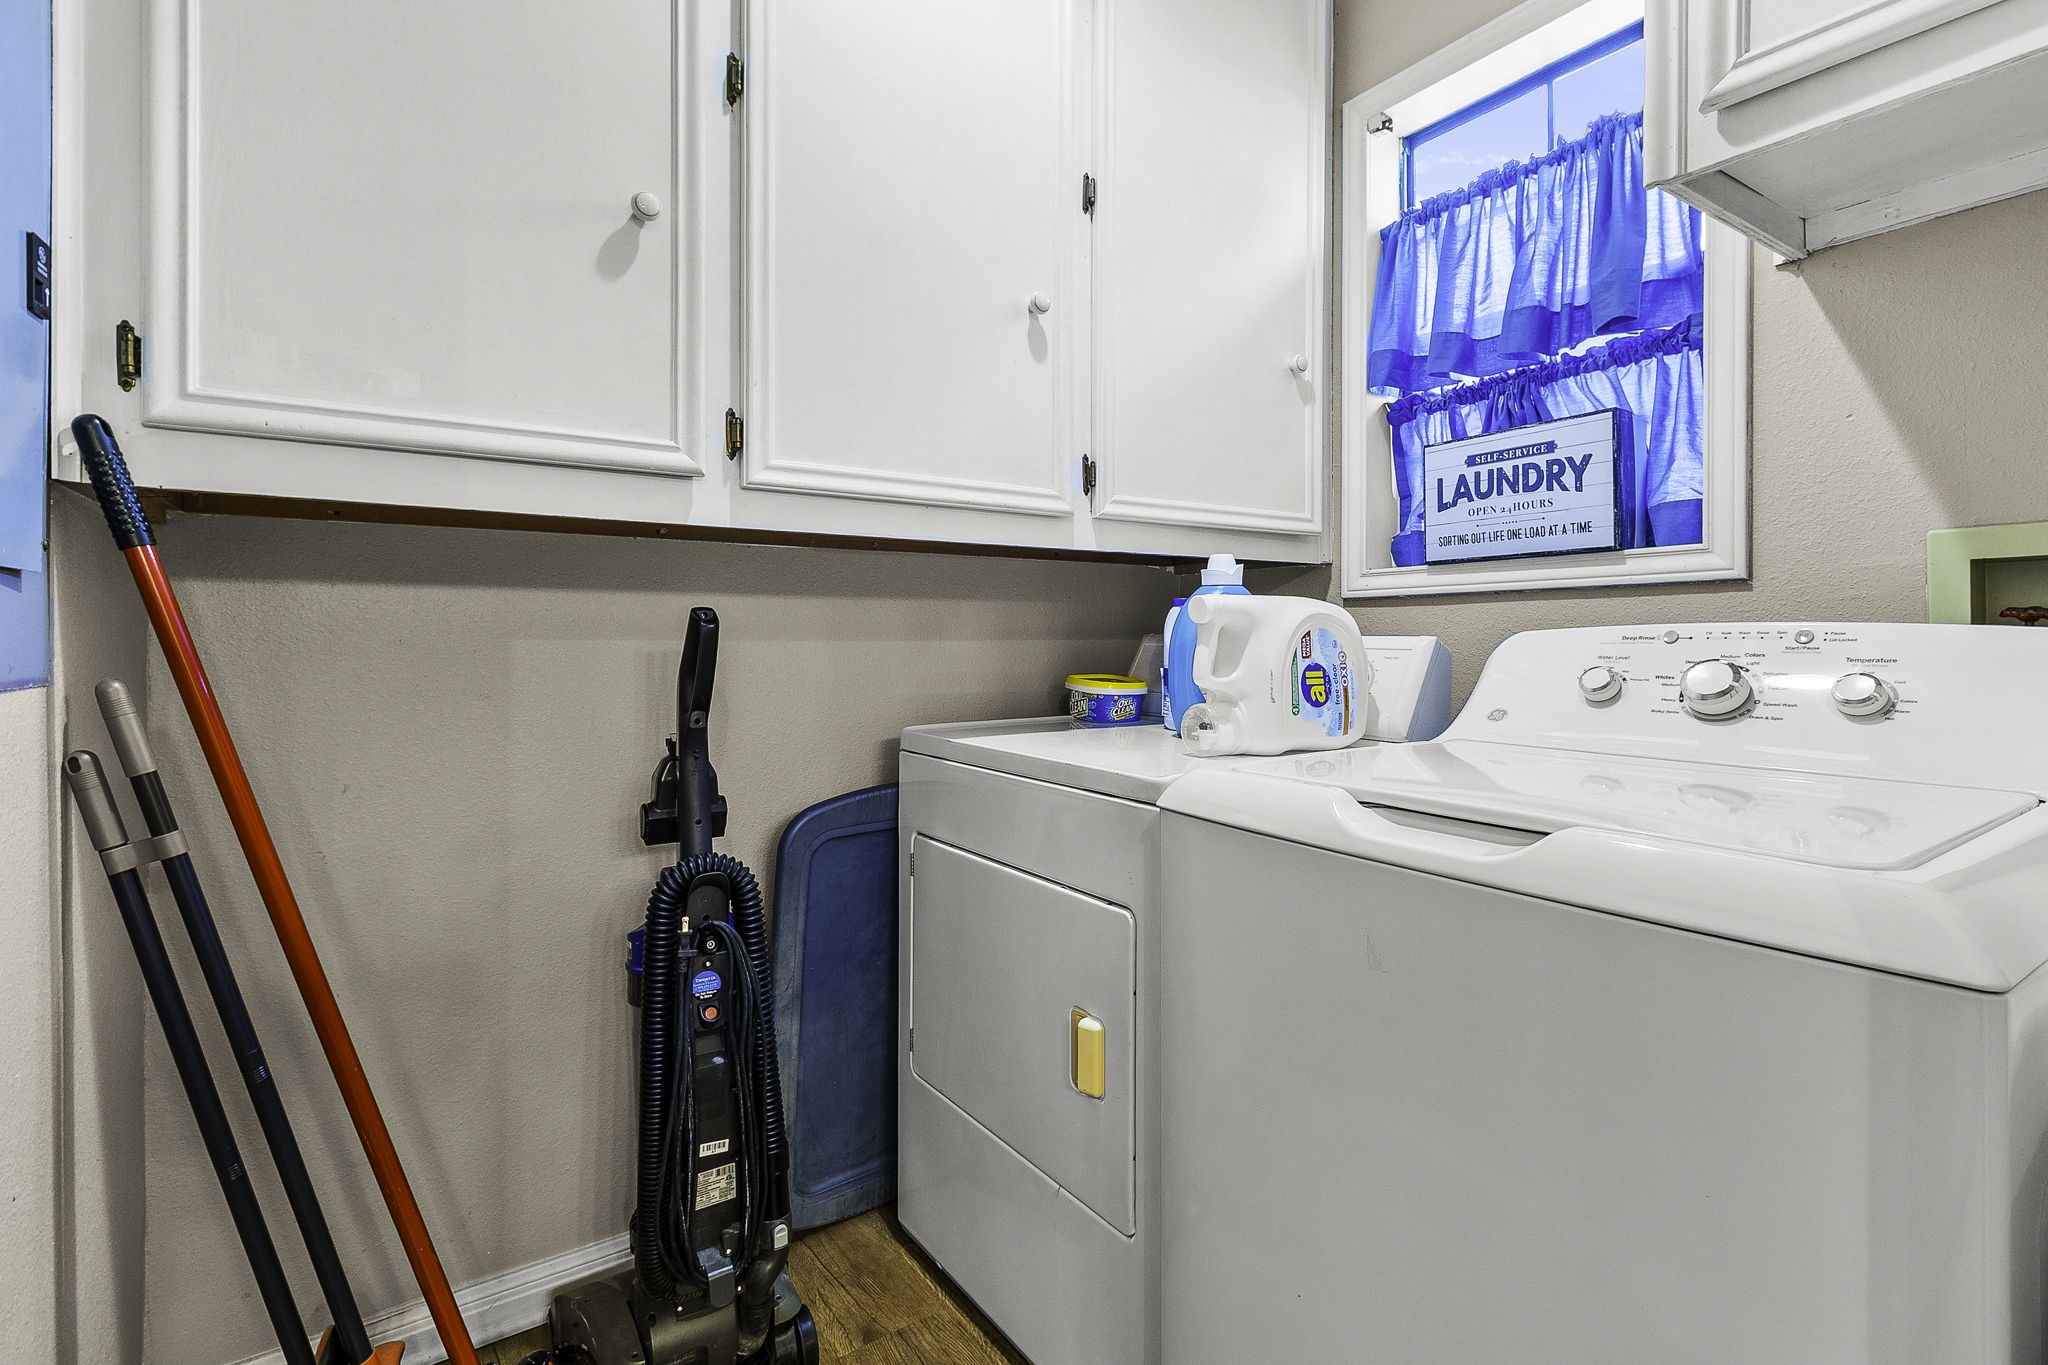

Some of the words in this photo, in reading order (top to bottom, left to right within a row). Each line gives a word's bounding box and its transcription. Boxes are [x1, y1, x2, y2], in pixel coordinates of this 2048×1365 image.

[1475, 444, 1548, 464] SELF-SERVICE
[1437, 453, 1593, 513] LAUNDRY
[1468, 505, 1497, 517] OPEN
[1438, 533, 1469, 547] SORTING
[1471, 532, 1487, 545] OUT
[1488, 529, 1505, 543] LIFE
[1507, 528, 1522, 541] ONE
[1524, 526, 1546, 539] LOAD
[1548, 524, 1559, 536] AT
[1561, 523, 1568, 535] A
[1570, 521, 1593, 534] TIME
[1306, 671, 1326, 702] all
[1112, 703, 1135, 716] CLEAN
[1118, 698, 1133, 709] OXI
